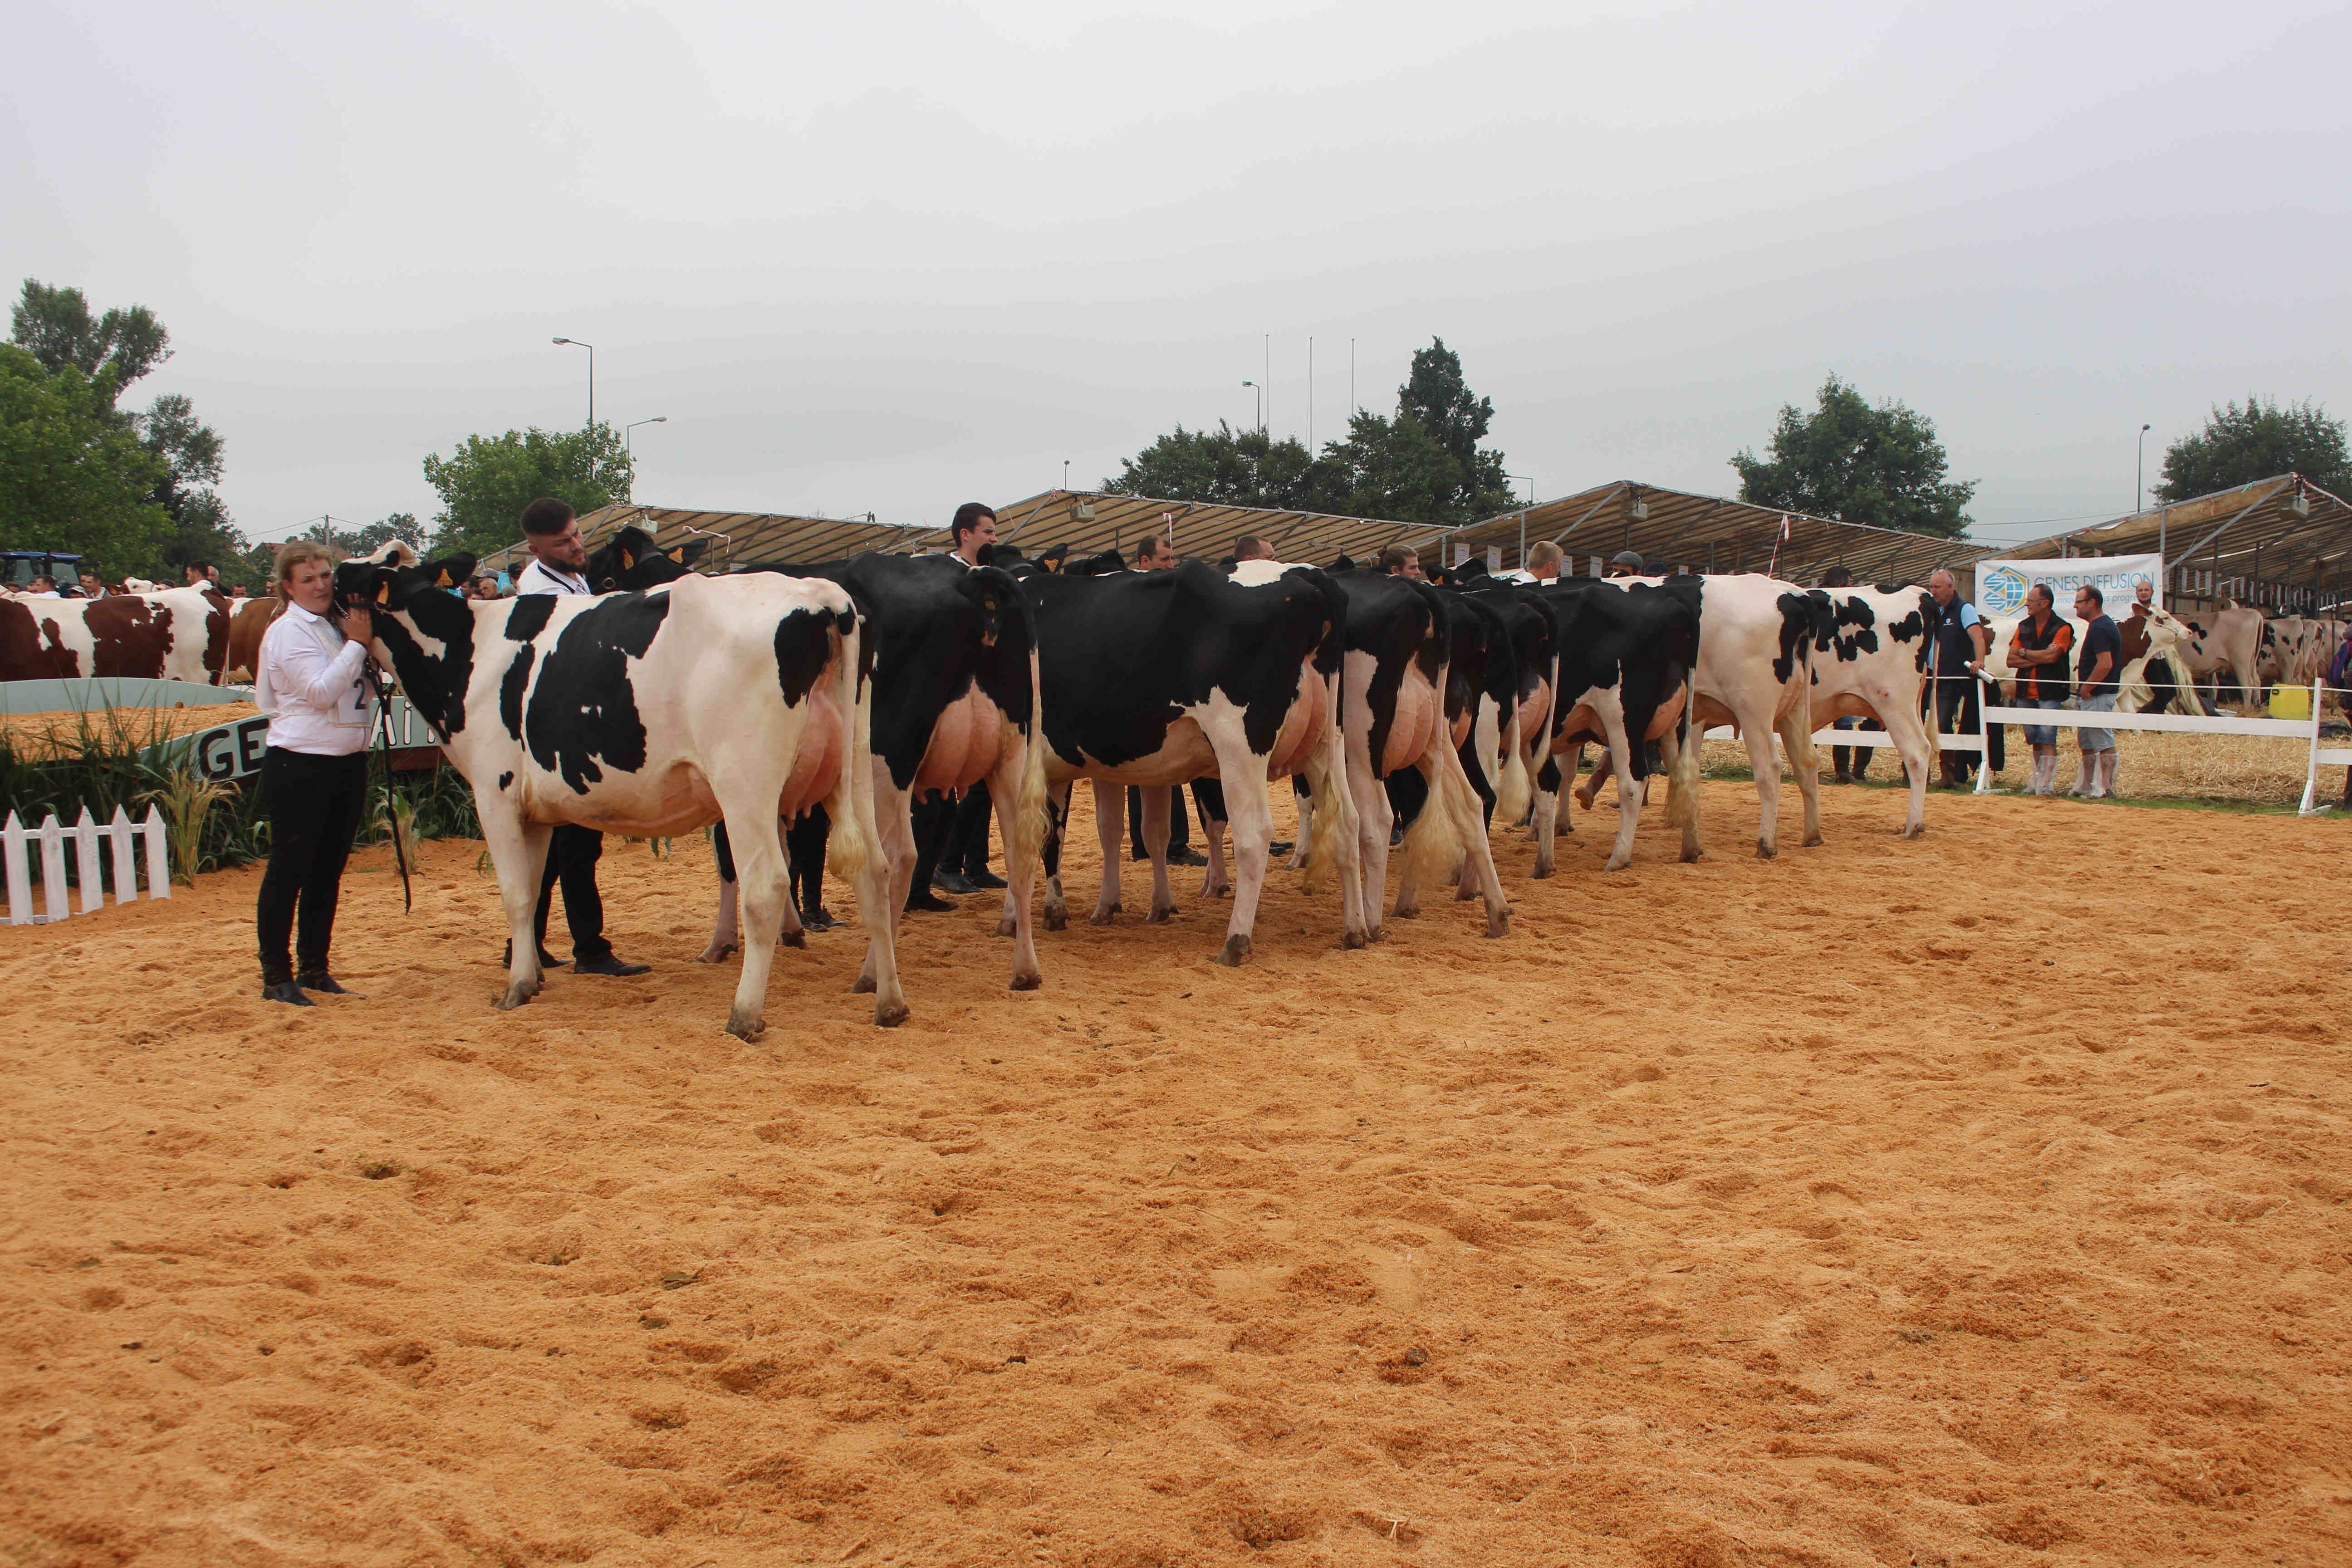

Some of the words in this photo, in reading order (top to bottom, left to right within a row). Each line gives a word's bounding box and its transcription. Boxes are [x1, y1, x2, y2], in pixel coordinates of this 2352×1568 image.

[2083, 572, 2154, 589] DIFFUSION
[2112, 594, 2137, 603] progre
[198, 718, 270, 779] GE
